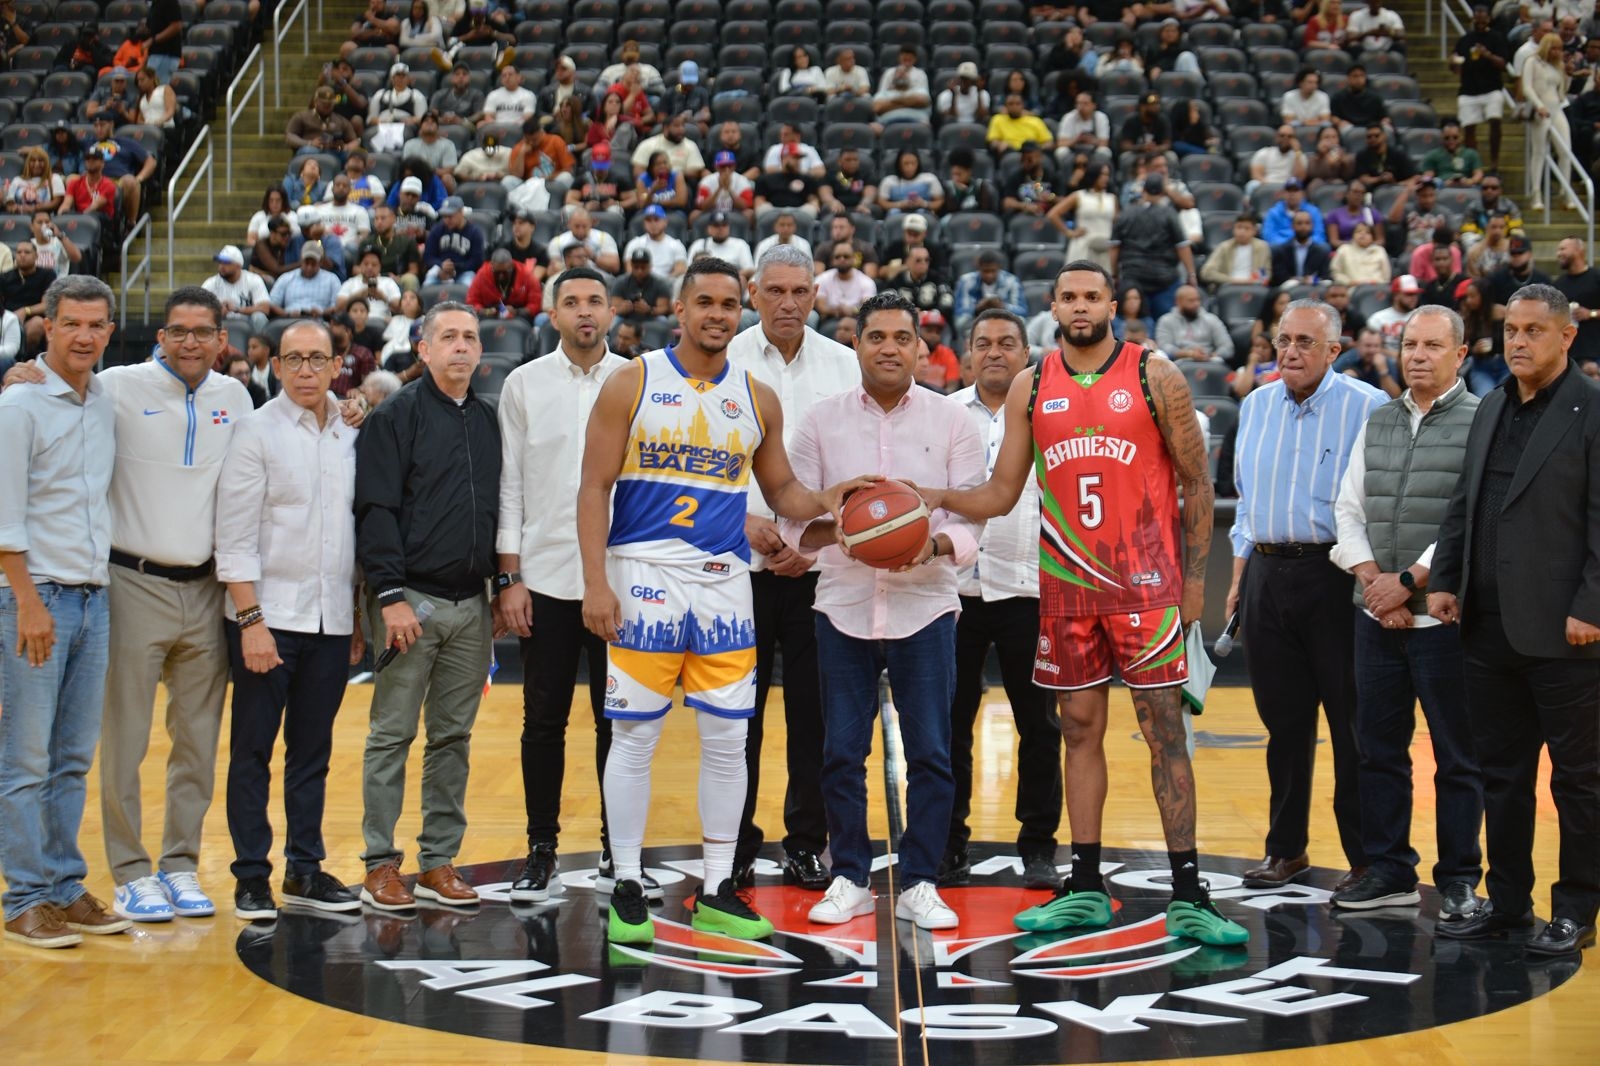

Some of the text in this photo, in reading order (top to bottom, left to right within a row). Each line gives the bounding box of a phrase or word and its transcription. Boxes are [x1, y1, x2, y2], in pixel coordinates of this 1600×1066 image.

[651, 393, 682, 404] GBC
[1045, 400, 1067, 410] GBC
[638, 441, 729, 462] MAURICIO
[1043, 435, 1137, 471] BAMESO
[639, 452, 726, 479] BAEZ
[669, 495, 699, 528] 2
[1077, 473, 1104, 529] 5
[630, 585, 666, 601] GBC
[374, 955, 1422, 1041] AL BASKET
